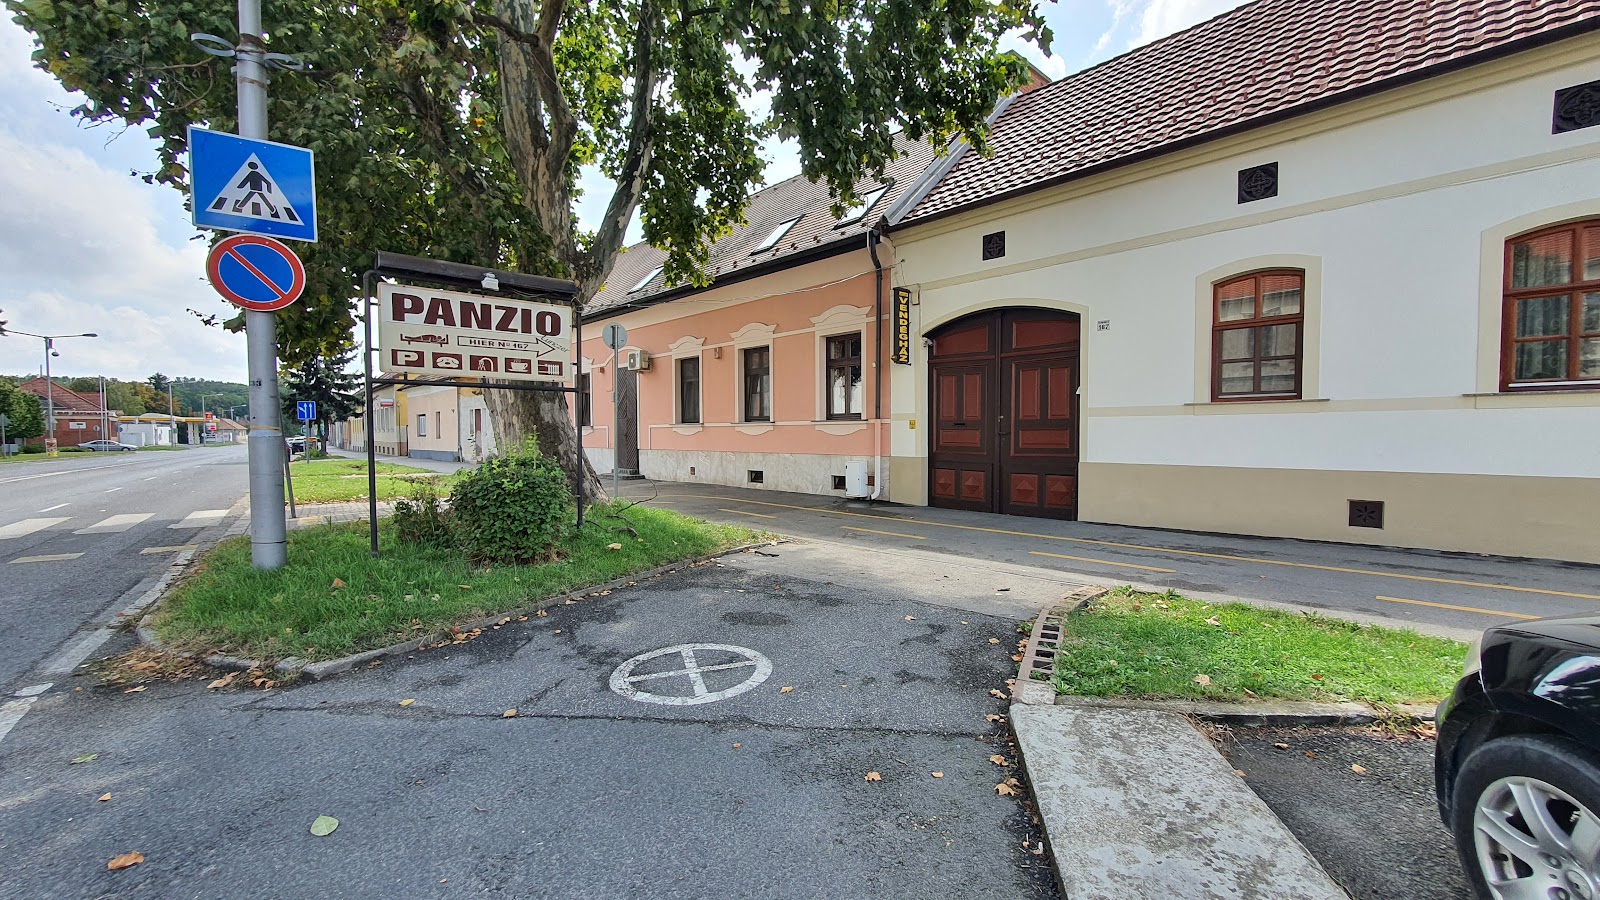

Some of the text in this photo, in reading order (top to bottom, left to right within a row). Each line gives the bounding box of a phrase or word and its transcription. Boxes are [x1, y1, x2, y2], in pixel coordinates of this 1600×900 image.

[391, 292, 562, 337] PANZIO
[469, 338, 495, 347] HIER
[397, 351, 419, 365] P
